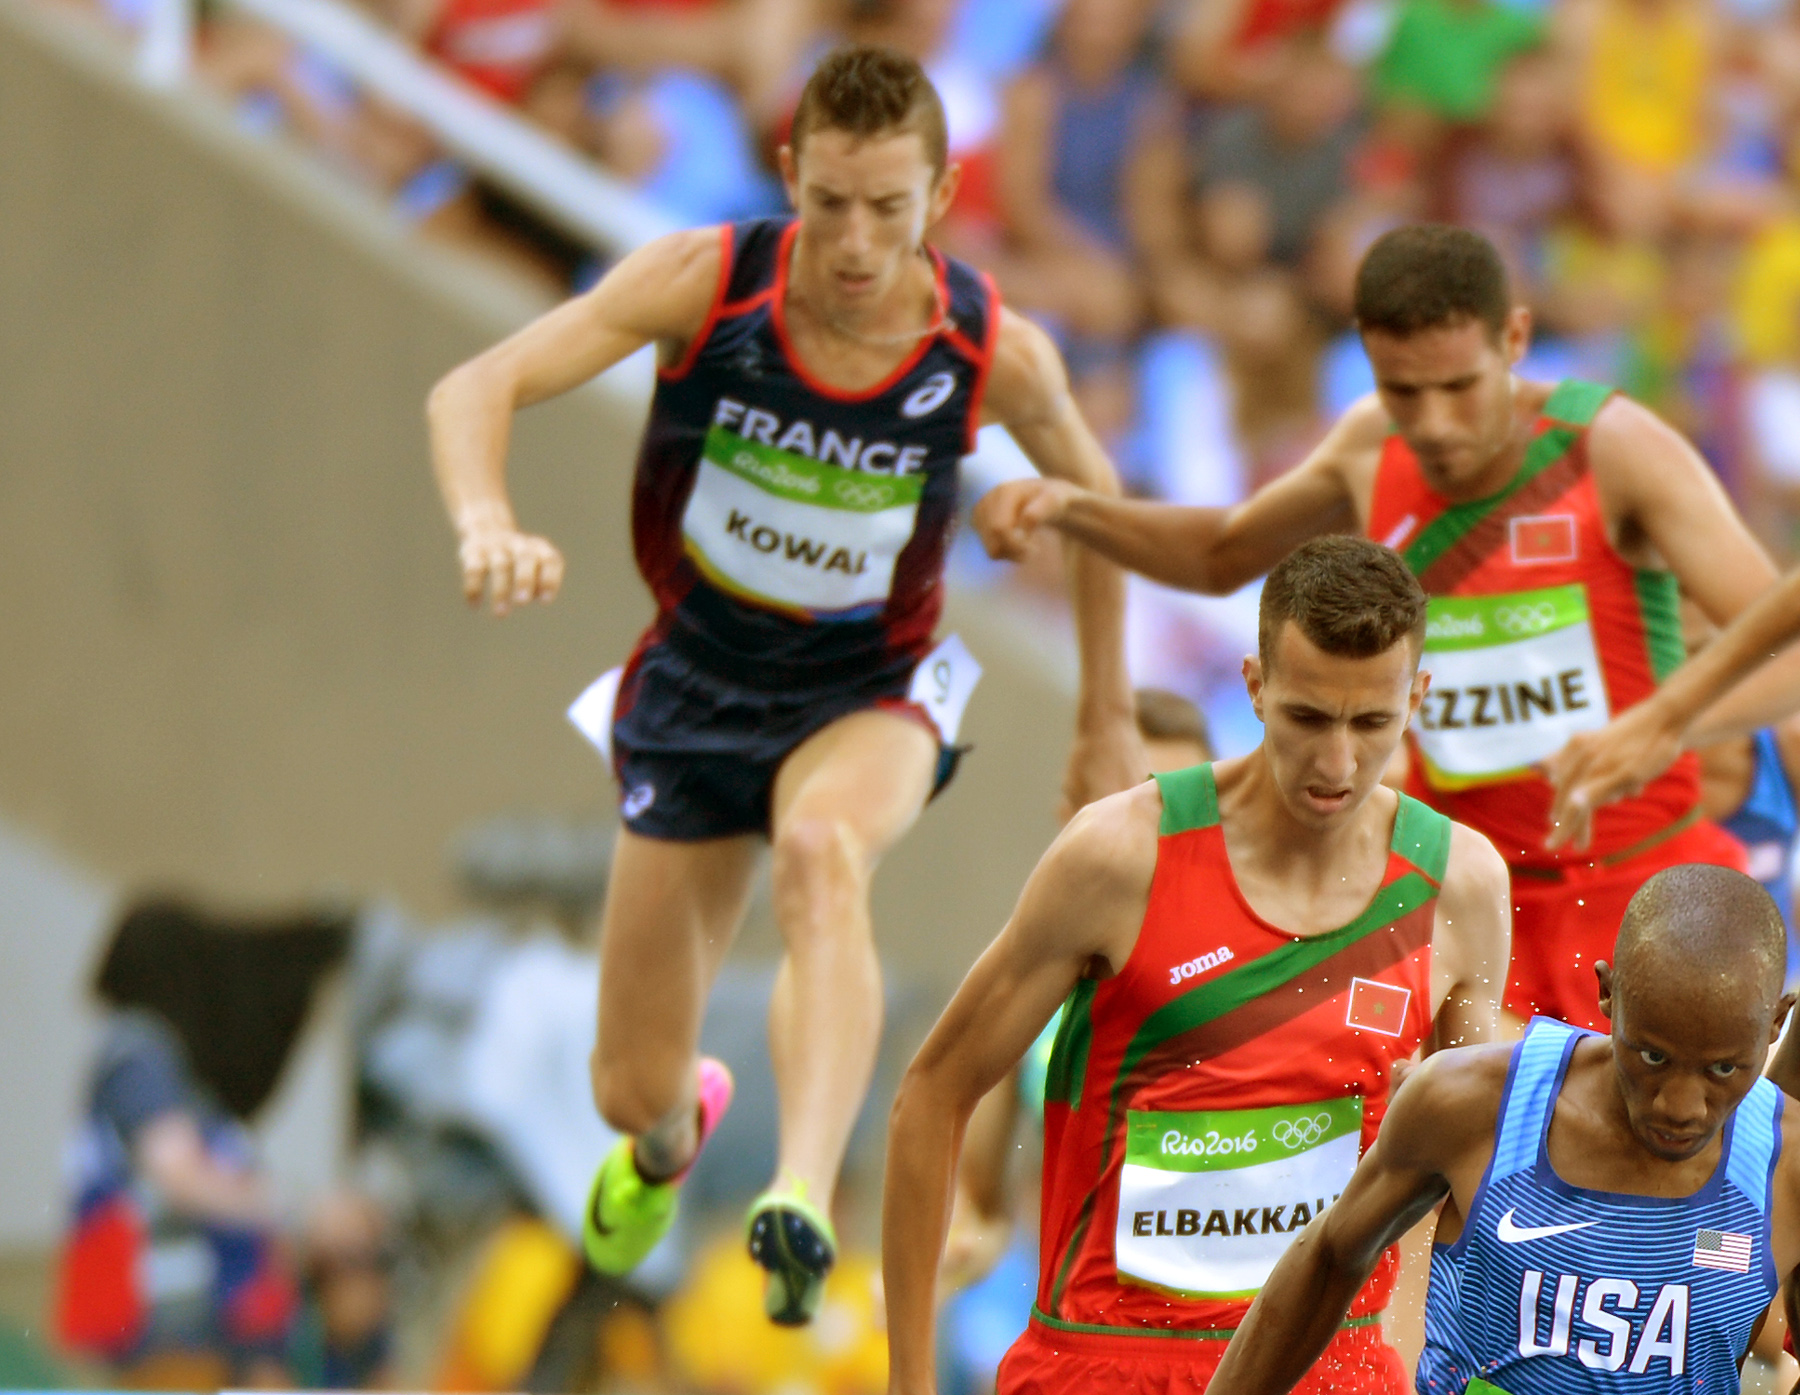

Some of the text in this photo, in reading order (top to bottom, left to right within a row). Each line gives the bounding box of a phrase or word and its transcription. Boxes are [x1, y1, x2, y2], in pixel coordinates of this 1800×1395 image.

[714, 397, 928, 477] FRANCE
[933, 659, 951, 704] 9
[1162, 1128, 1258, 1156] Rio2016
[1519, 1270, 1690, 1377] USA
